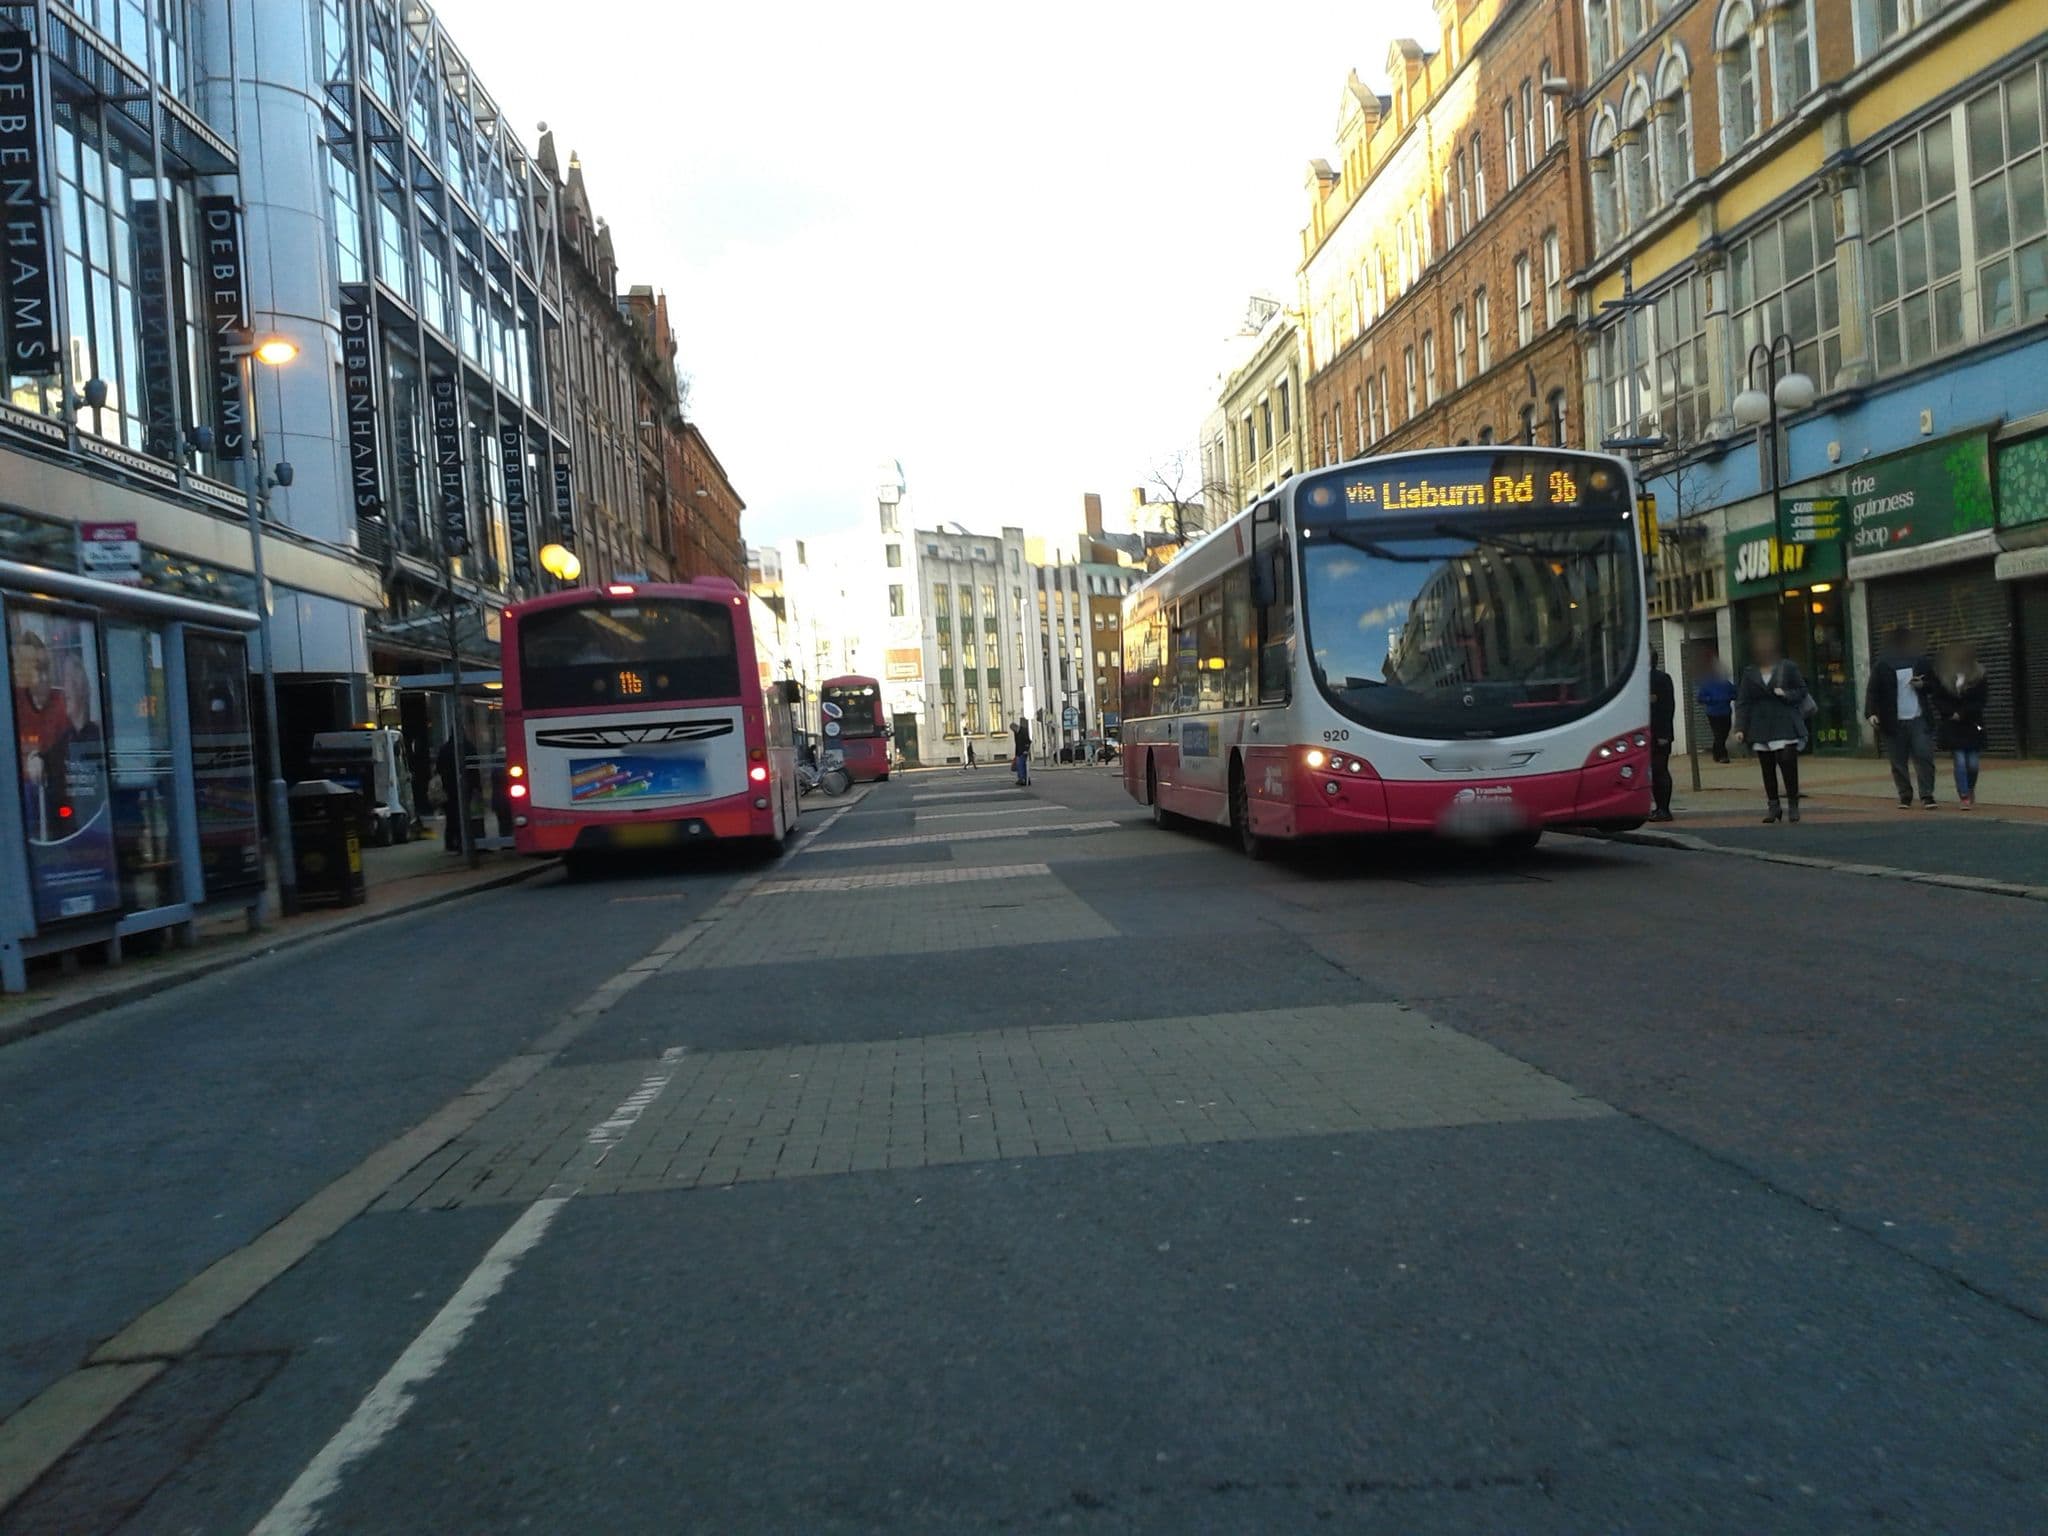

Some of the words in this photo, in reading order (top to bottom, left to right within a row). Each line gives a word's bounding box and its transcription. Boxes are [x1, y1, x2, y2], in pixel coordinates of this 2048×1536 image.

[0, 48, 45, 359] DEBENHAMS
[207, 209, 242, 448] DEBENHAMS
[345, 314, 377, 508] DEBENHAMS
[503, 432, 532, 577] DEBENHAM
[1346, 482, 1376, 503] via
[1382, 480, 1485, 510] Lisburn
[1493, 473, 1534, 504] Rd
[1549, 471, 1578, 503] 9b
[1851, 476, 1876, 496] the
[1853, 490, 1915, 526] guinness
[1854, 526, 1889, 548] shop
[1323, 729, 1350, 742] 920
